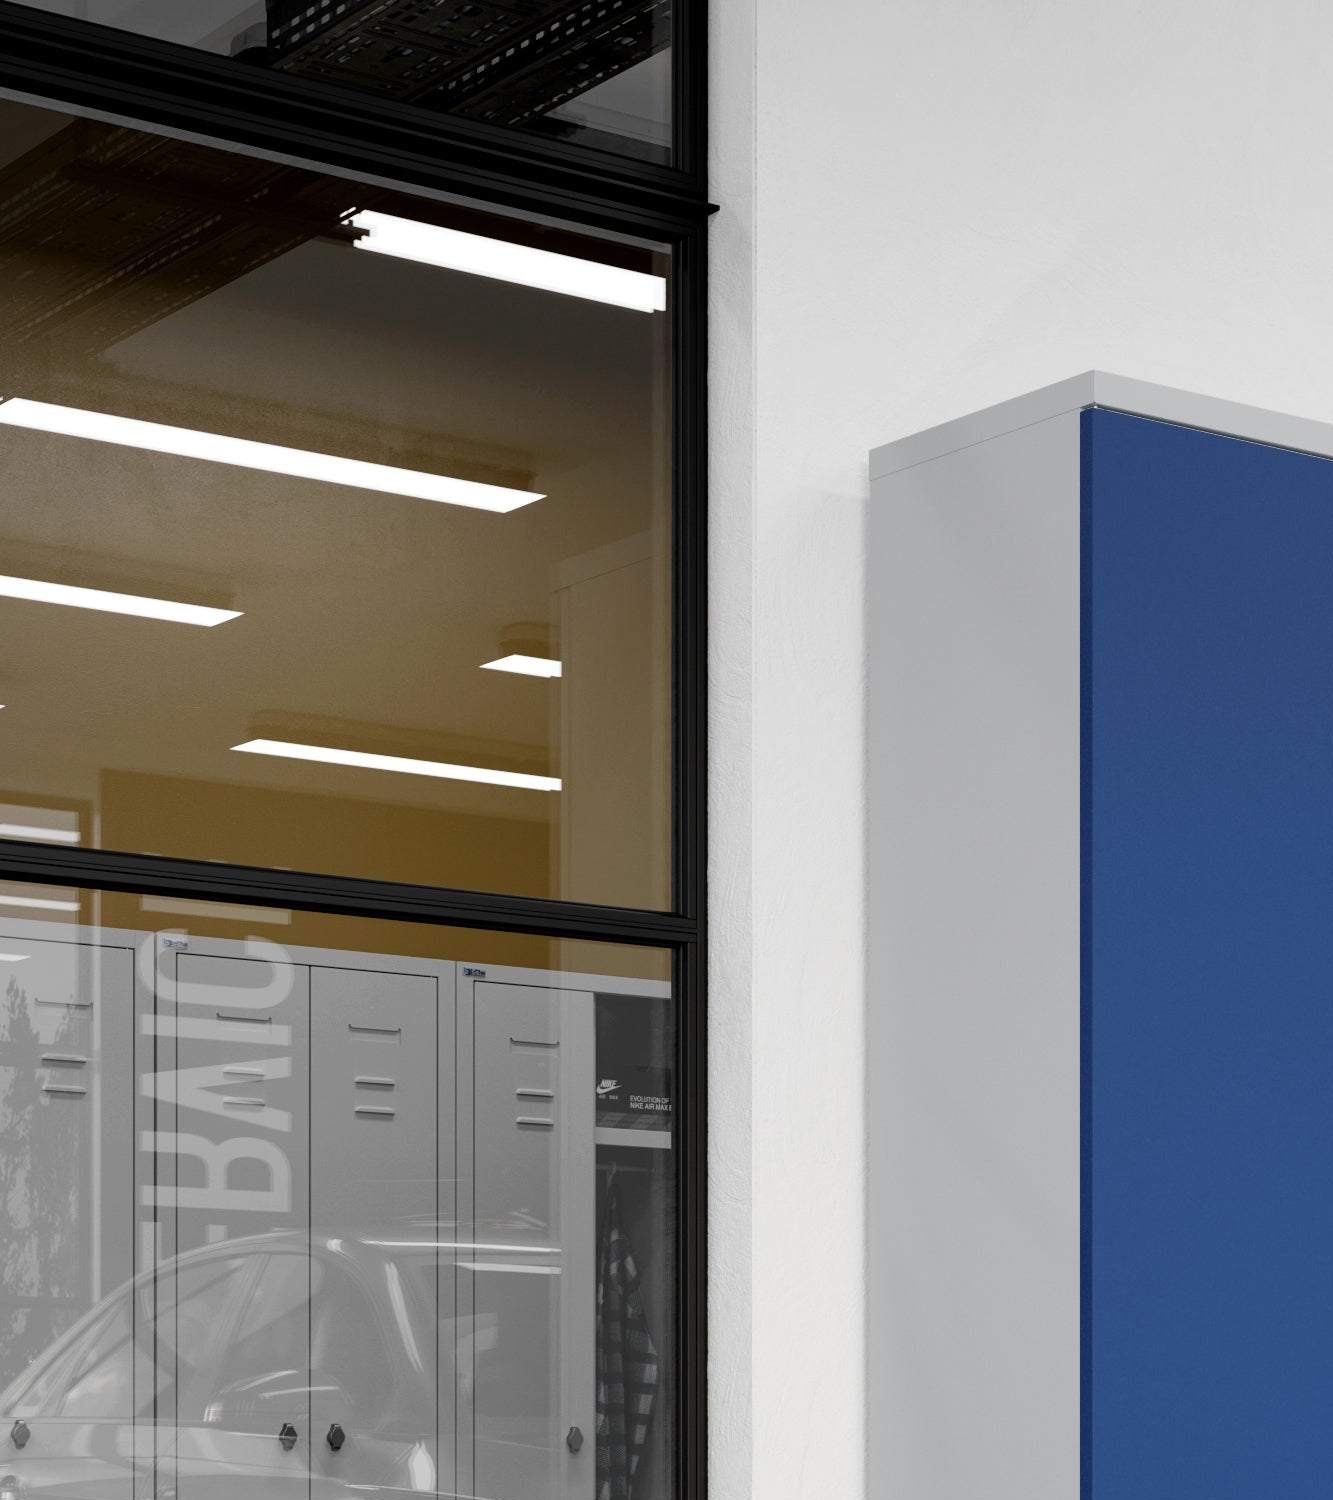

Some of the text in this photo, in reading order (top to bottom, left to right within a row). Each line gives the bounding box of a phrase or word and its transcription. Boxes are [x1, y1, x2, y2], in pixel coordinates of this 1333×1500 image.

[600, 1078, 618, 1088] NIKE
[629, 1095, 661, 1104] EVOLUTION
[629, 1102, 644, 1110] NIKE
